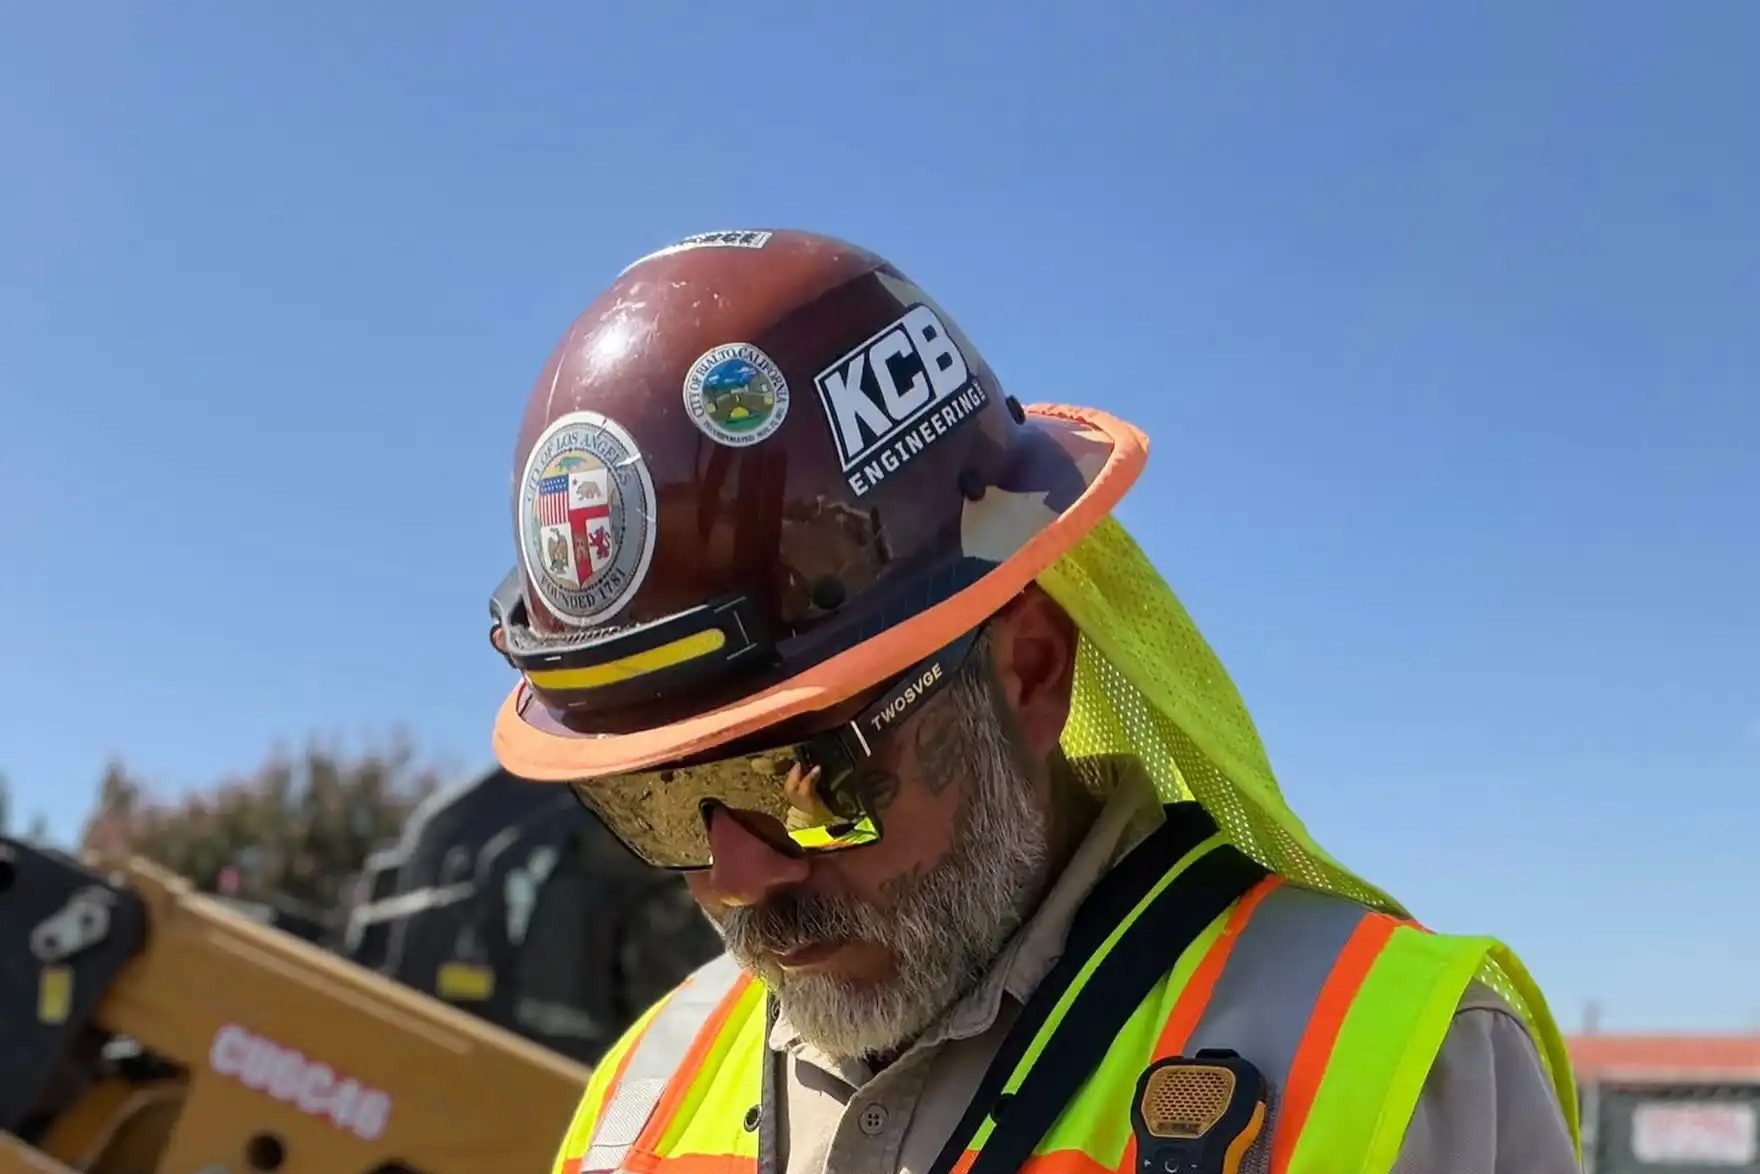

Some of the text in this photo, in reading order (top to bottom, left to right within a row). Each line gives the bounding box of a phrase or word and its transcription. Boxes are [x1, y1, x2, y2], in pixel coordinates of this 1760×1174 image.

[738, 347, 787, 404] CALIFORNIA
[823, 305, 968, 459] KCB
[540, 444, 554, 466] OF
[555, 431, 578, 451] LOS
[540, 567, 626, 609] FOUNDED 1781
[871, 662, 943, 731] TWOSVGE
